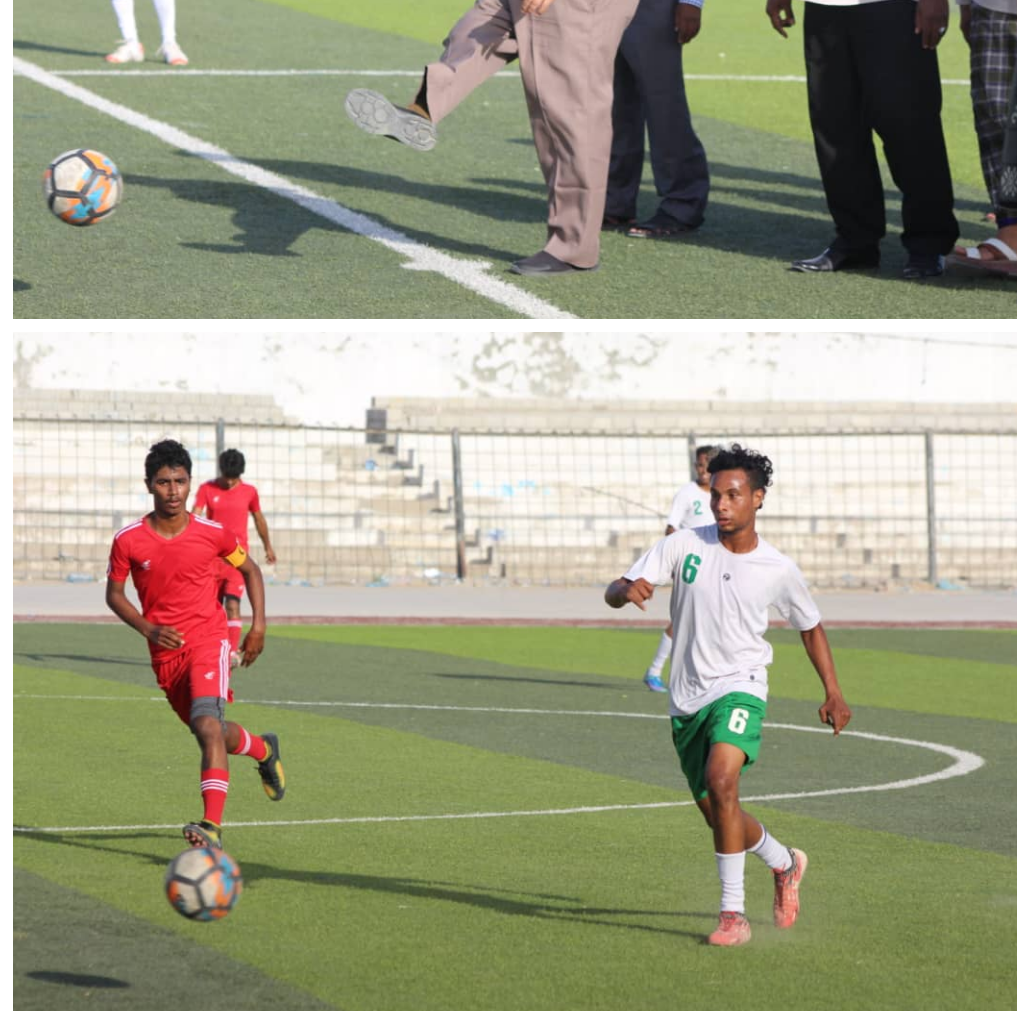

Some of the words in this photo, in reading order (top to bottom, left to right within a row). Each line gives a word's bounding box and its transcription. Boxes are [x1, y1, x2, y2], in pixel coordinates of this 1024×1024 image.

[693, 500, 703, 516] 2
[682, 553, 701, 585] 6
[727, 707, 749, 734] 6
